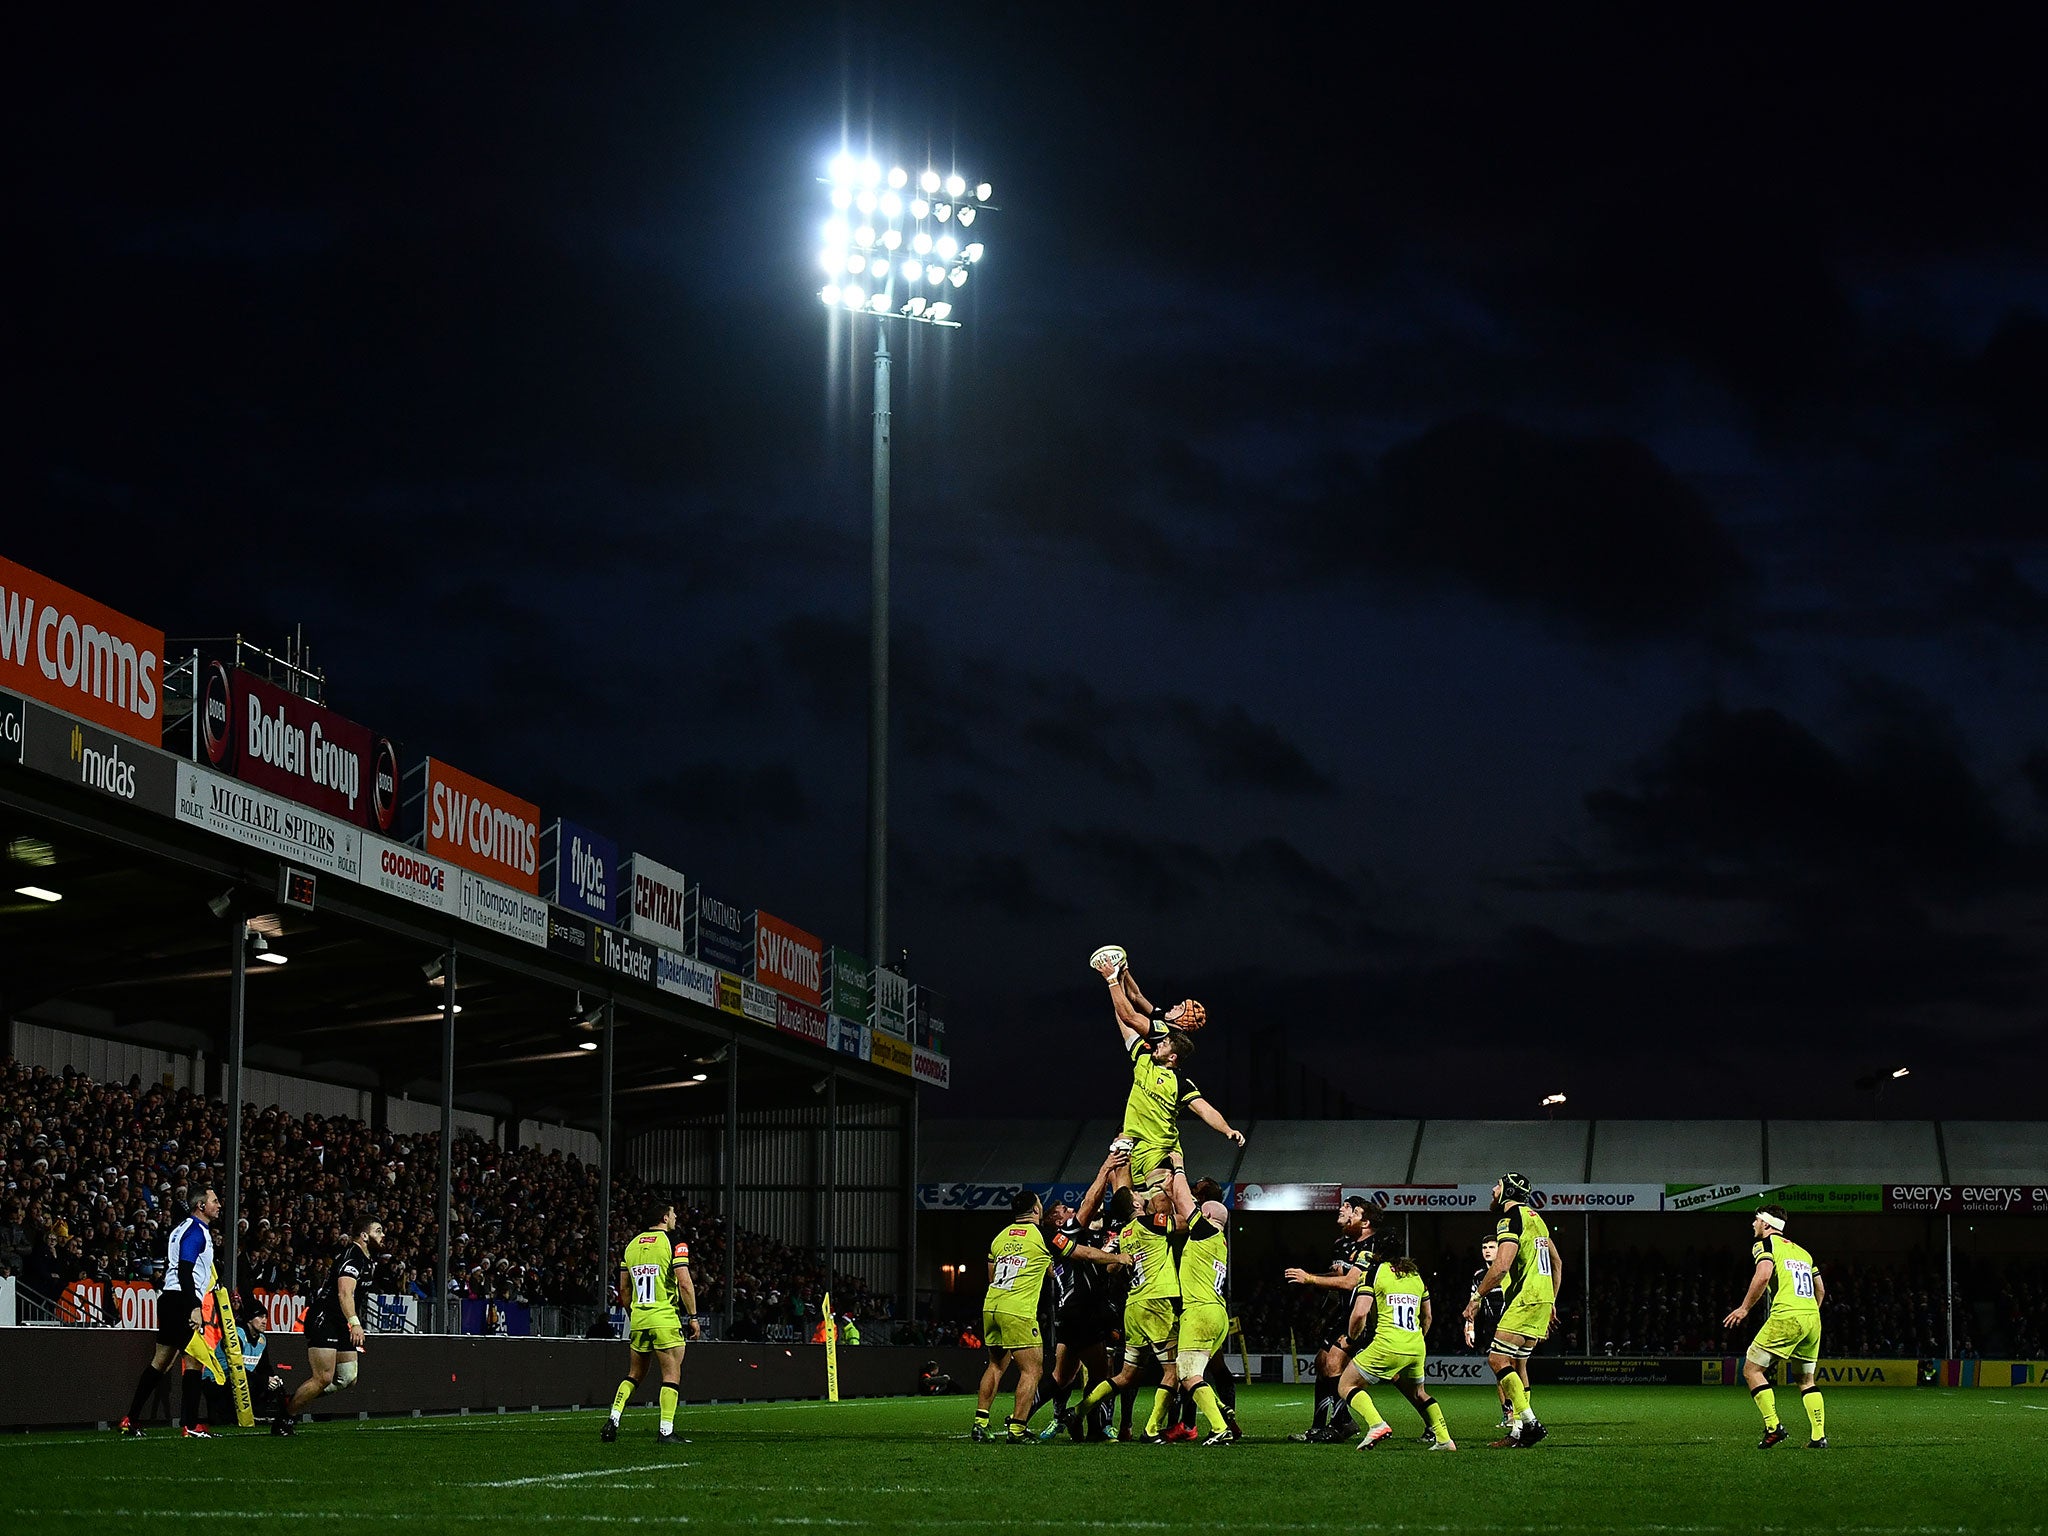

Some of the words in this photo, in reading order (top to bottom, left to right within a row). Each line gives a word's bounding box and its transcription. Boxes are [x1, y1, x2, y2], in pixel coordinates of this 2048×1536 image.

[0, 584, 158, 720] wcomms
[248, 692, 306, 778] Boden
[309, 720, 359, 811] Group
[81, 743, 136, 799] midas
[180, 798, 204, 821] ROLEX
[209, 784, 282, 834] MICHAEL
[284, 812, 335, 855] SPIERS
[337, 854, 358, 876] ROLEX
[381, 848, 445, 892] GOODRIDGE
[475, 878, 519, 921] Thompson
[520, 896, 546, 930] Jenner
[634, 873, 682, 935] CENTRAX
[475, 908, 507, 932] Chartered
[508, 920, 545, 946] Accountants
[603, 928, 621, 972] The
[622, 936, 652, 983] Exeter
[1393, 1194, 1477, 1207] SWHGROUP
[1551, 1194, 1635, 1207] SWHGROUP
[1672, 1185, 1742, 1210] Inter-Line
[1778, 1191, 1825, 1204] Building
[1828, 1191, 1879, 1204] Supplies
[1892, 1187, 1952, 1210] everys
[1892, 1201, 1935, 1211] solicitors
[1962, 1187, 2022, 1211] everys
[1962, 1202, 2004, 1212] solicitors
[1795, 1271, 1813, 1297] 20
[1397, 1305, 1415, 1331] 16
[225, 1318, 238, 1349] AVIVA
[1815, 1367, 1886, 1382] AVIVA
[238, 1379, 250, 1410] AVIVA
